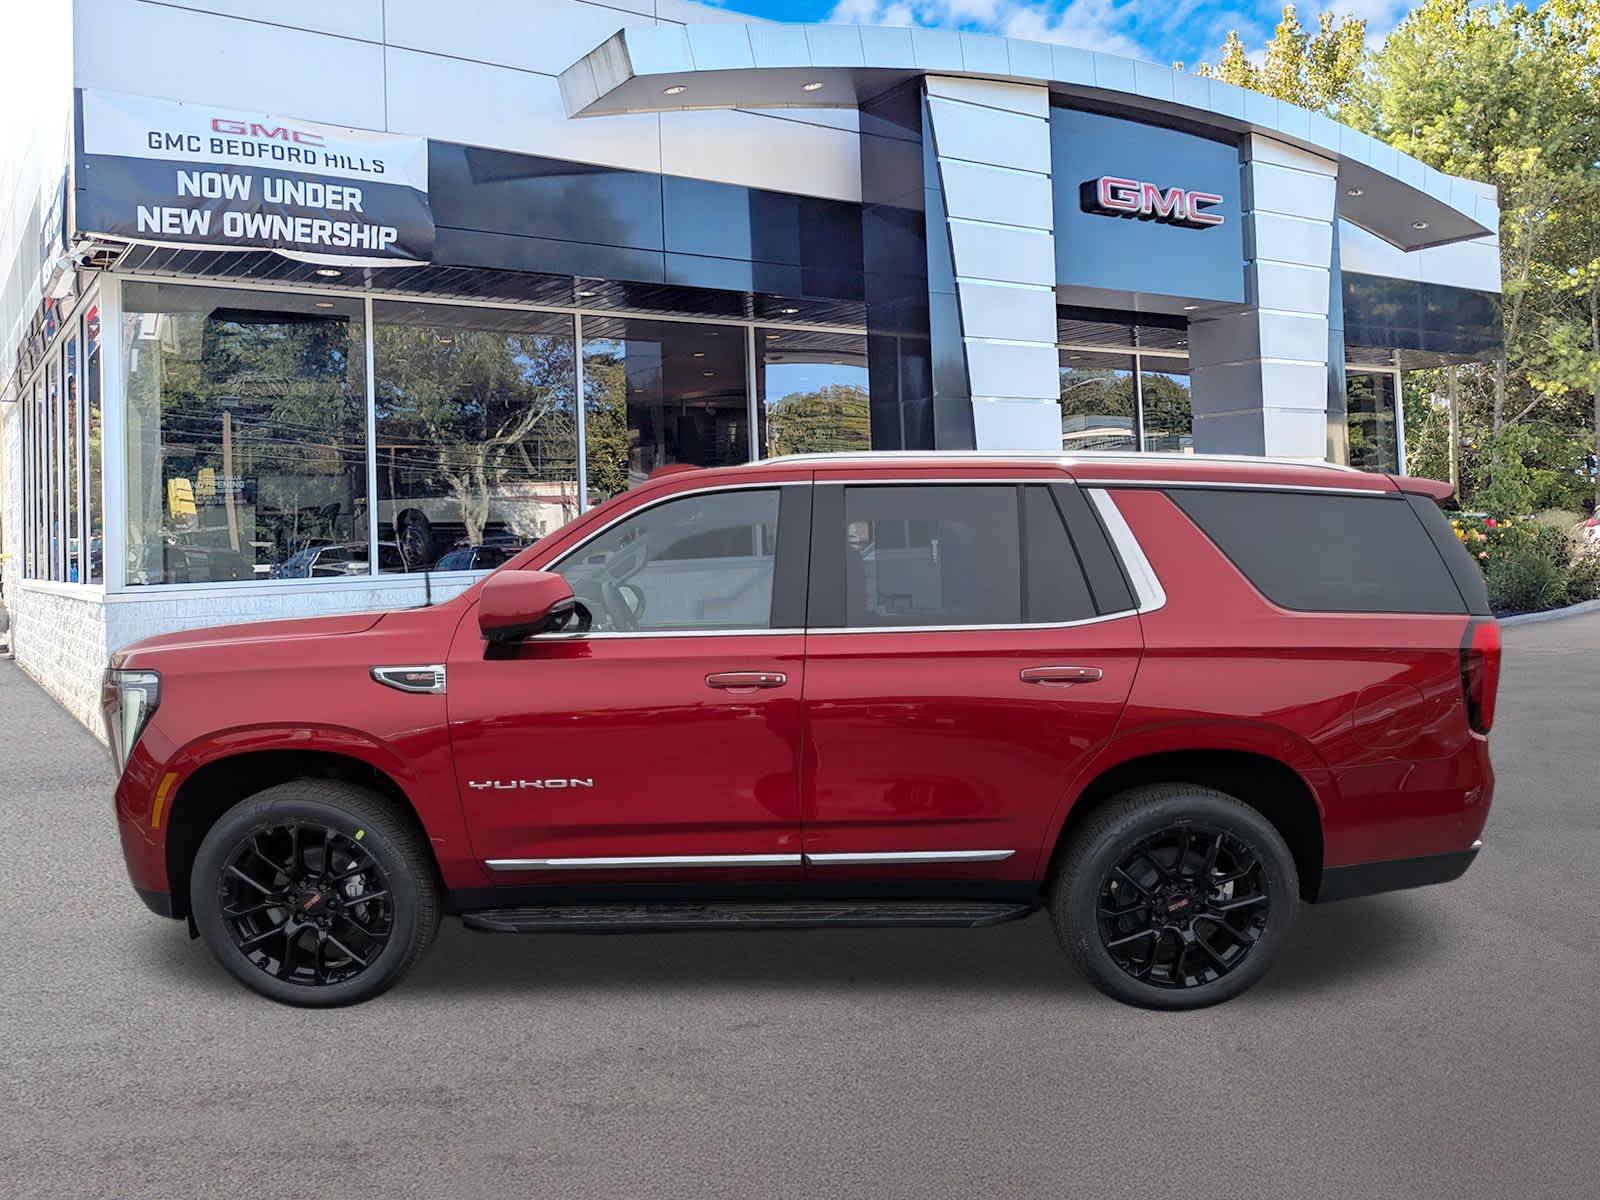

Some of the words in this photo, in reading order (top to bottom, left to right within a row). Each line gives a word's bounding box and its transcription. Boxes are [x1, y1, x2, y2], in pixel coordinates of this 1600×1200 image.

[148, 131, 201, 153] GMC
[210, 138, 316, 166] BEDFORD
[325, 153, 386, 174] HILLS
[211, 118, 326, 149] GMC
[177, 170, 252, 201] NOW
[263, 177, 363, 213] UNDER
[1097, 175, 1225, 225] GMC
[137, 205, 212, 236] NEW
[223, 211, 398, 250] OWNERSHIP
[406, 672, 435, 681] GMC
[468, 778, 593, 790] YUKON
